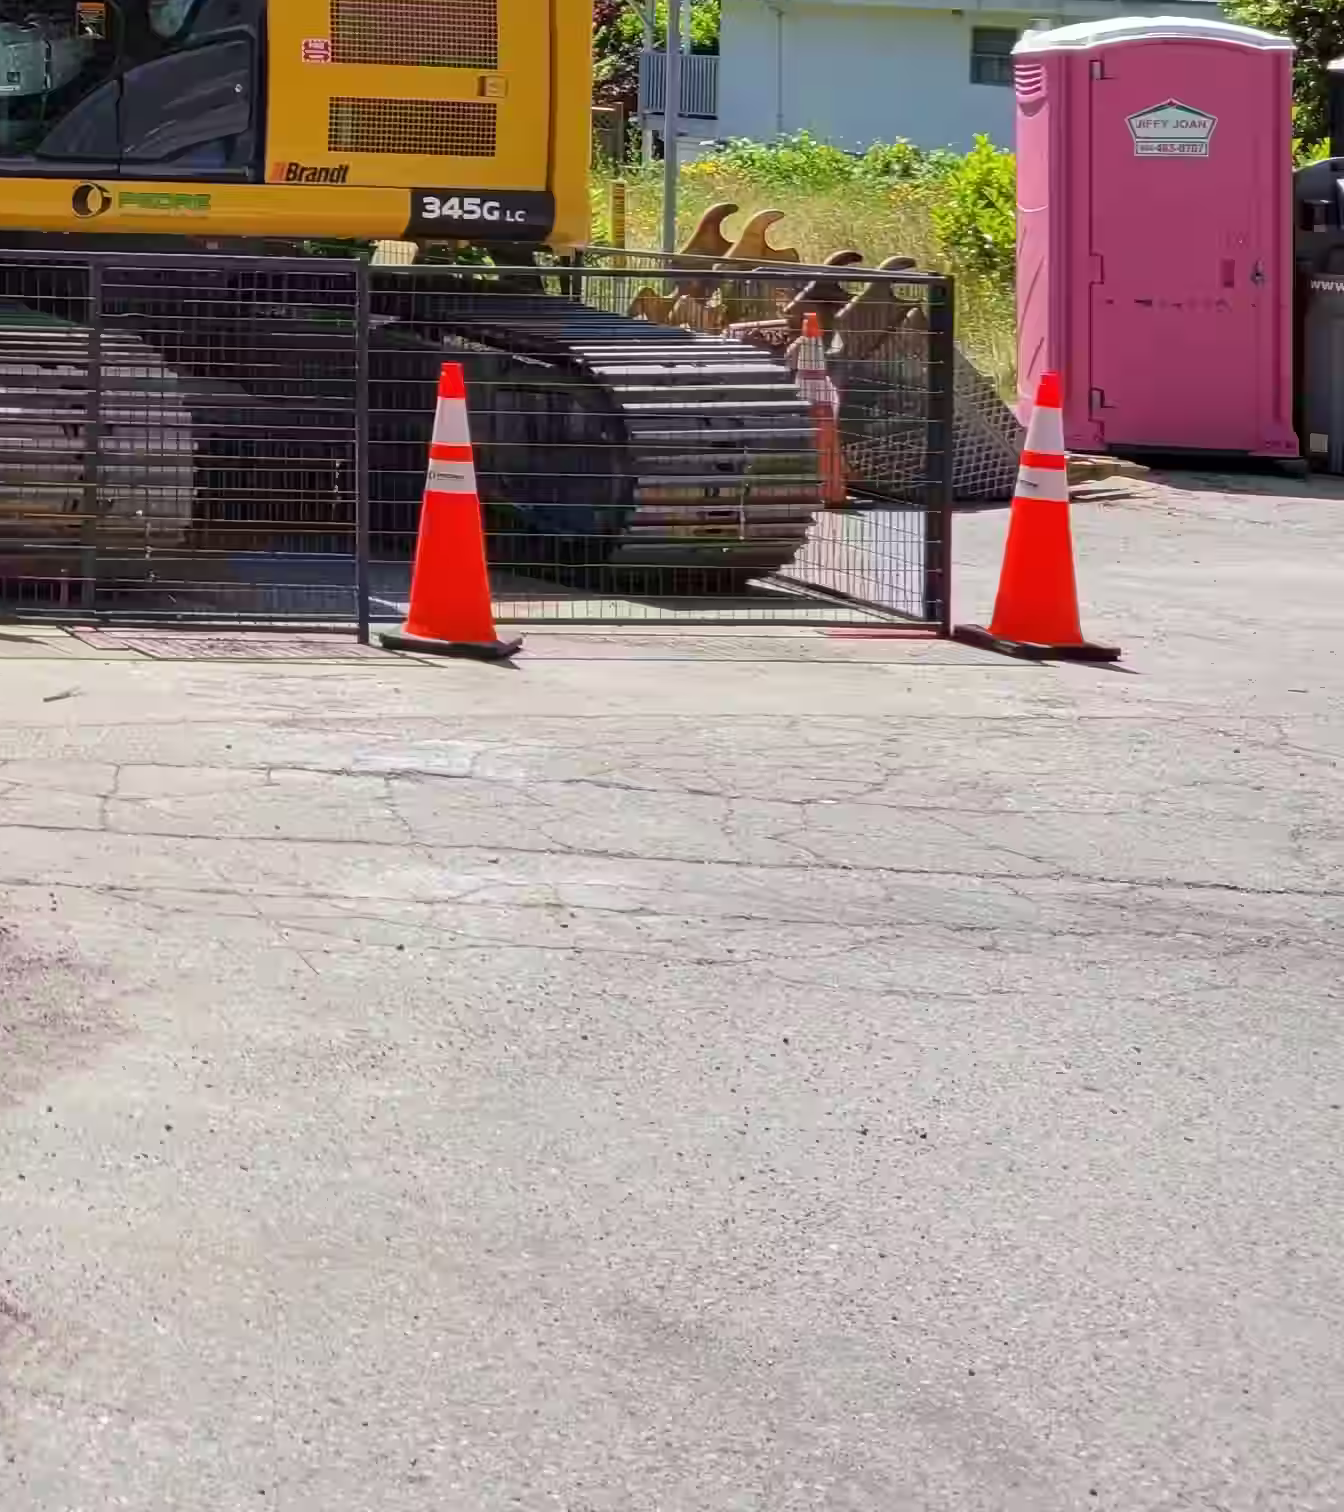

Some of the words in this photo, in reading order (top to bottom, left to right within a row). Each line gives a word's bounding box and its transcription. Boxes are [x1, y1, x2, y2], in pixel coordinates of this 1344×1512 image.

[1136, 119, 1169, 129] JIFFY
[1172, 119, 1207, 129] JOAN
[421, 196, 500, 221] 345G
[505, 210, 526, 223] LC
